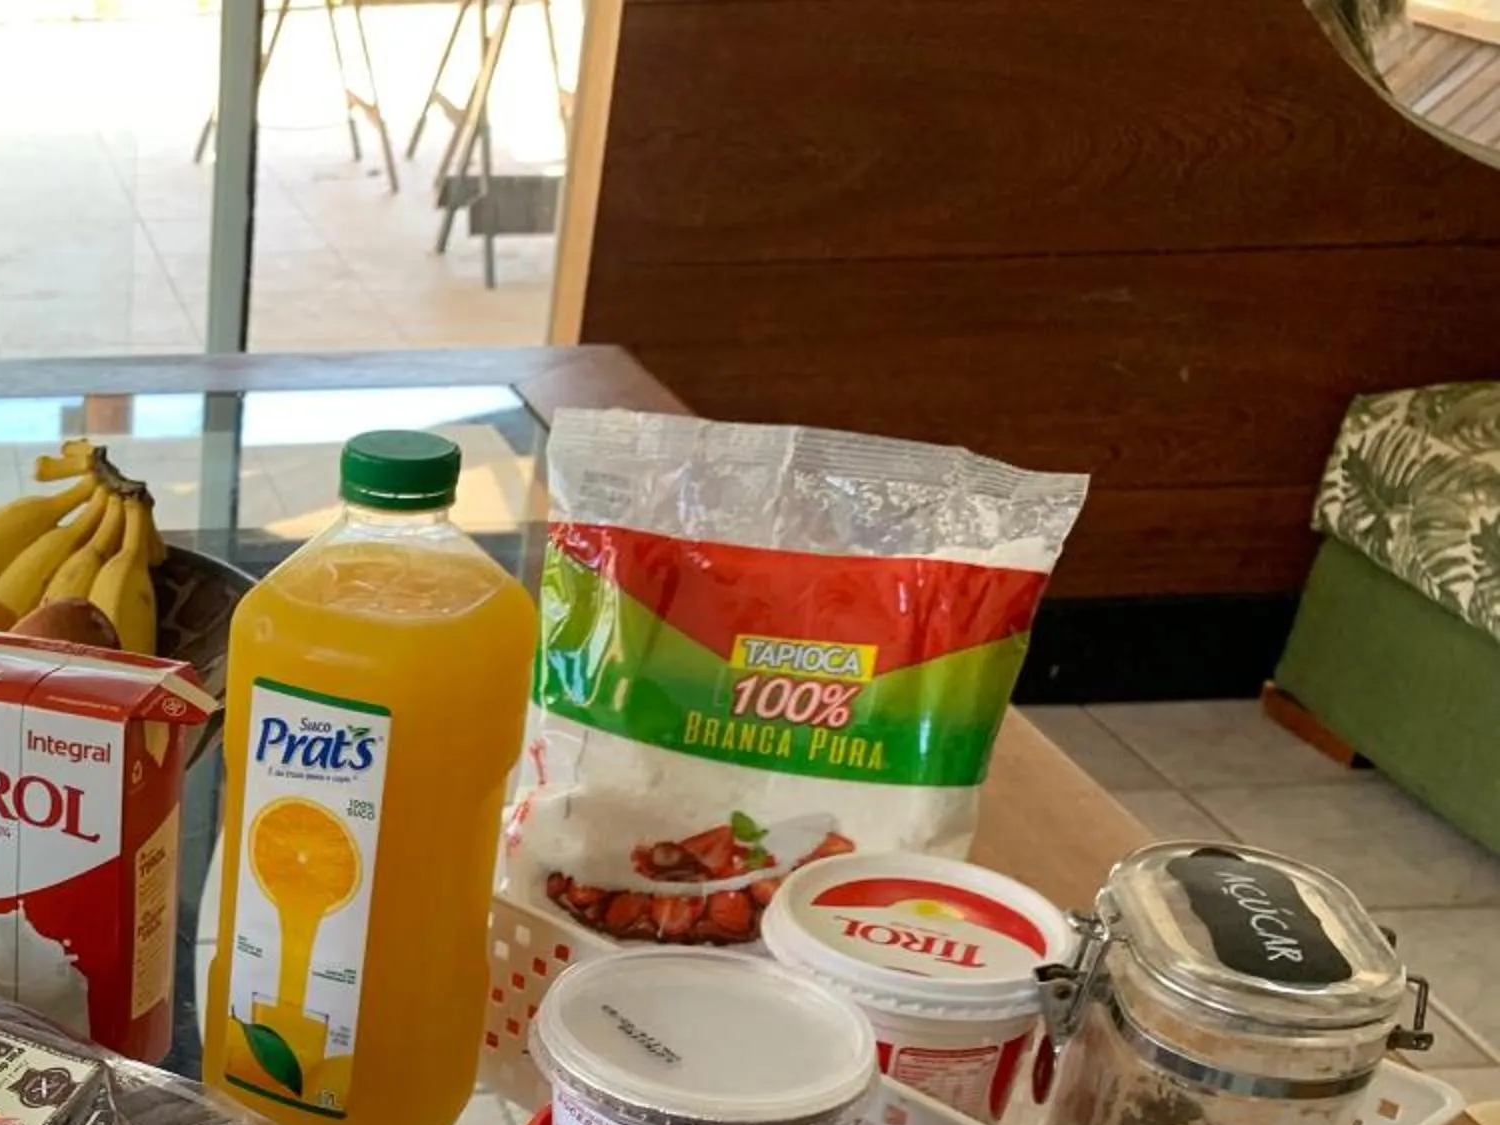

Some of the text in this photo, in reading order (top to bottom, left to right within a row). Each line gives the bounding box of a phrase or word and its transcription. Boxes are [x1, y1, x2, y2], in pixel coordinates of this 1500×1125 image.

[743, 639, 861, 676] TAPIOCA
[733, 674, 862, 729] 100%
[27, 730, 112, 763] Integral
[300, 718, 332, 733] Suco
[684, 710, 885, 770] BRANCA PURA
[833, 915, 987, 968] TIROL
